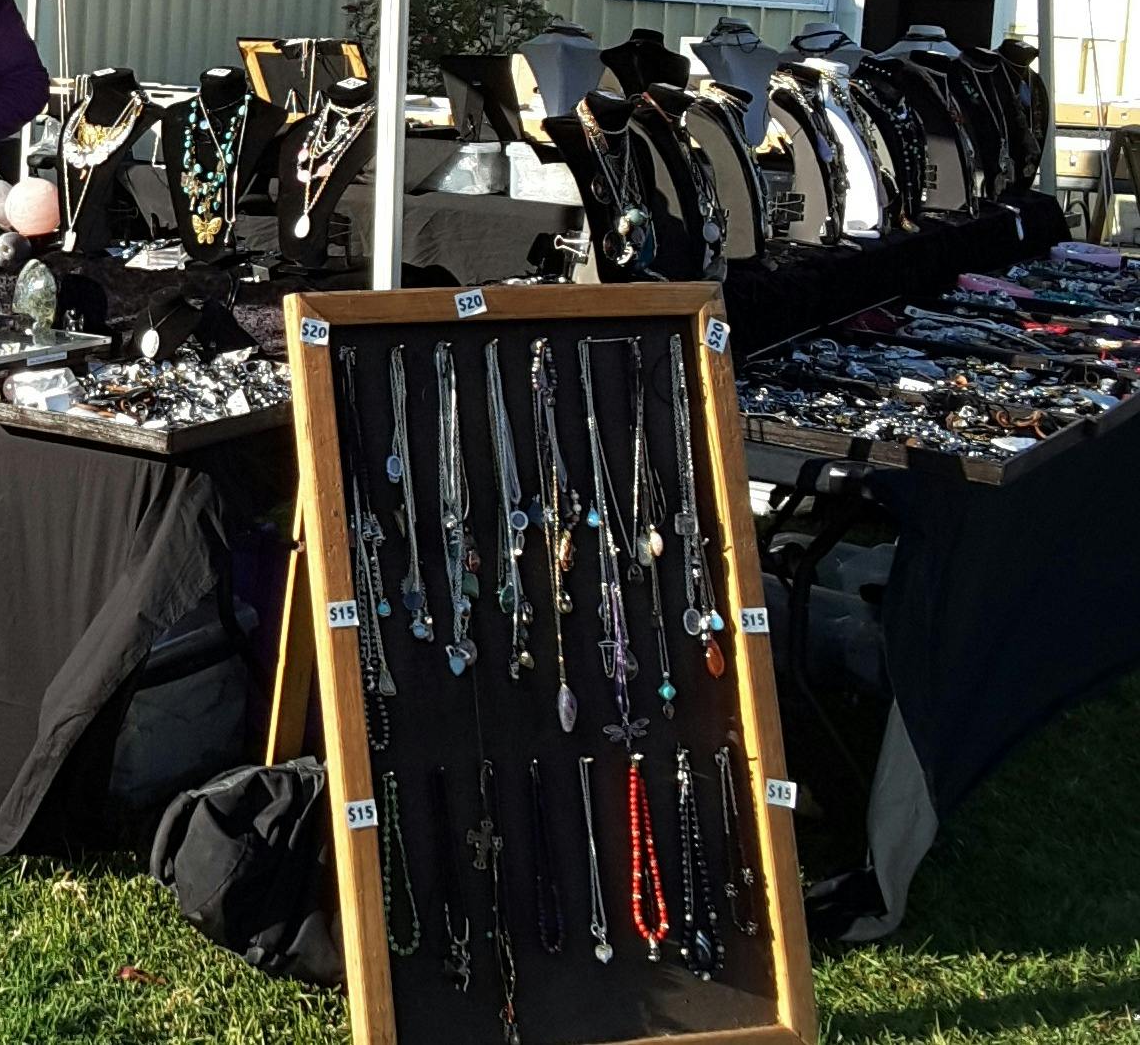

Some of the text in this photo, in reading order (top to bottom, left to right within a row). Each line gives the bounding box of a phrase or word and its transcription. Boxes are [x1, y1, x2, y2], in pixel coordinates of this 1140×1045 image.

[458, 295, 482, 312] $20
[302, 322, 327, 338] $20
[708, 322, 724, 349] $20
[330, 606, 355, 621] $15
[741, 613, 765, 627] $15
[768, 784, 791, 800] $15
[348, 805, 373, 822] $15
